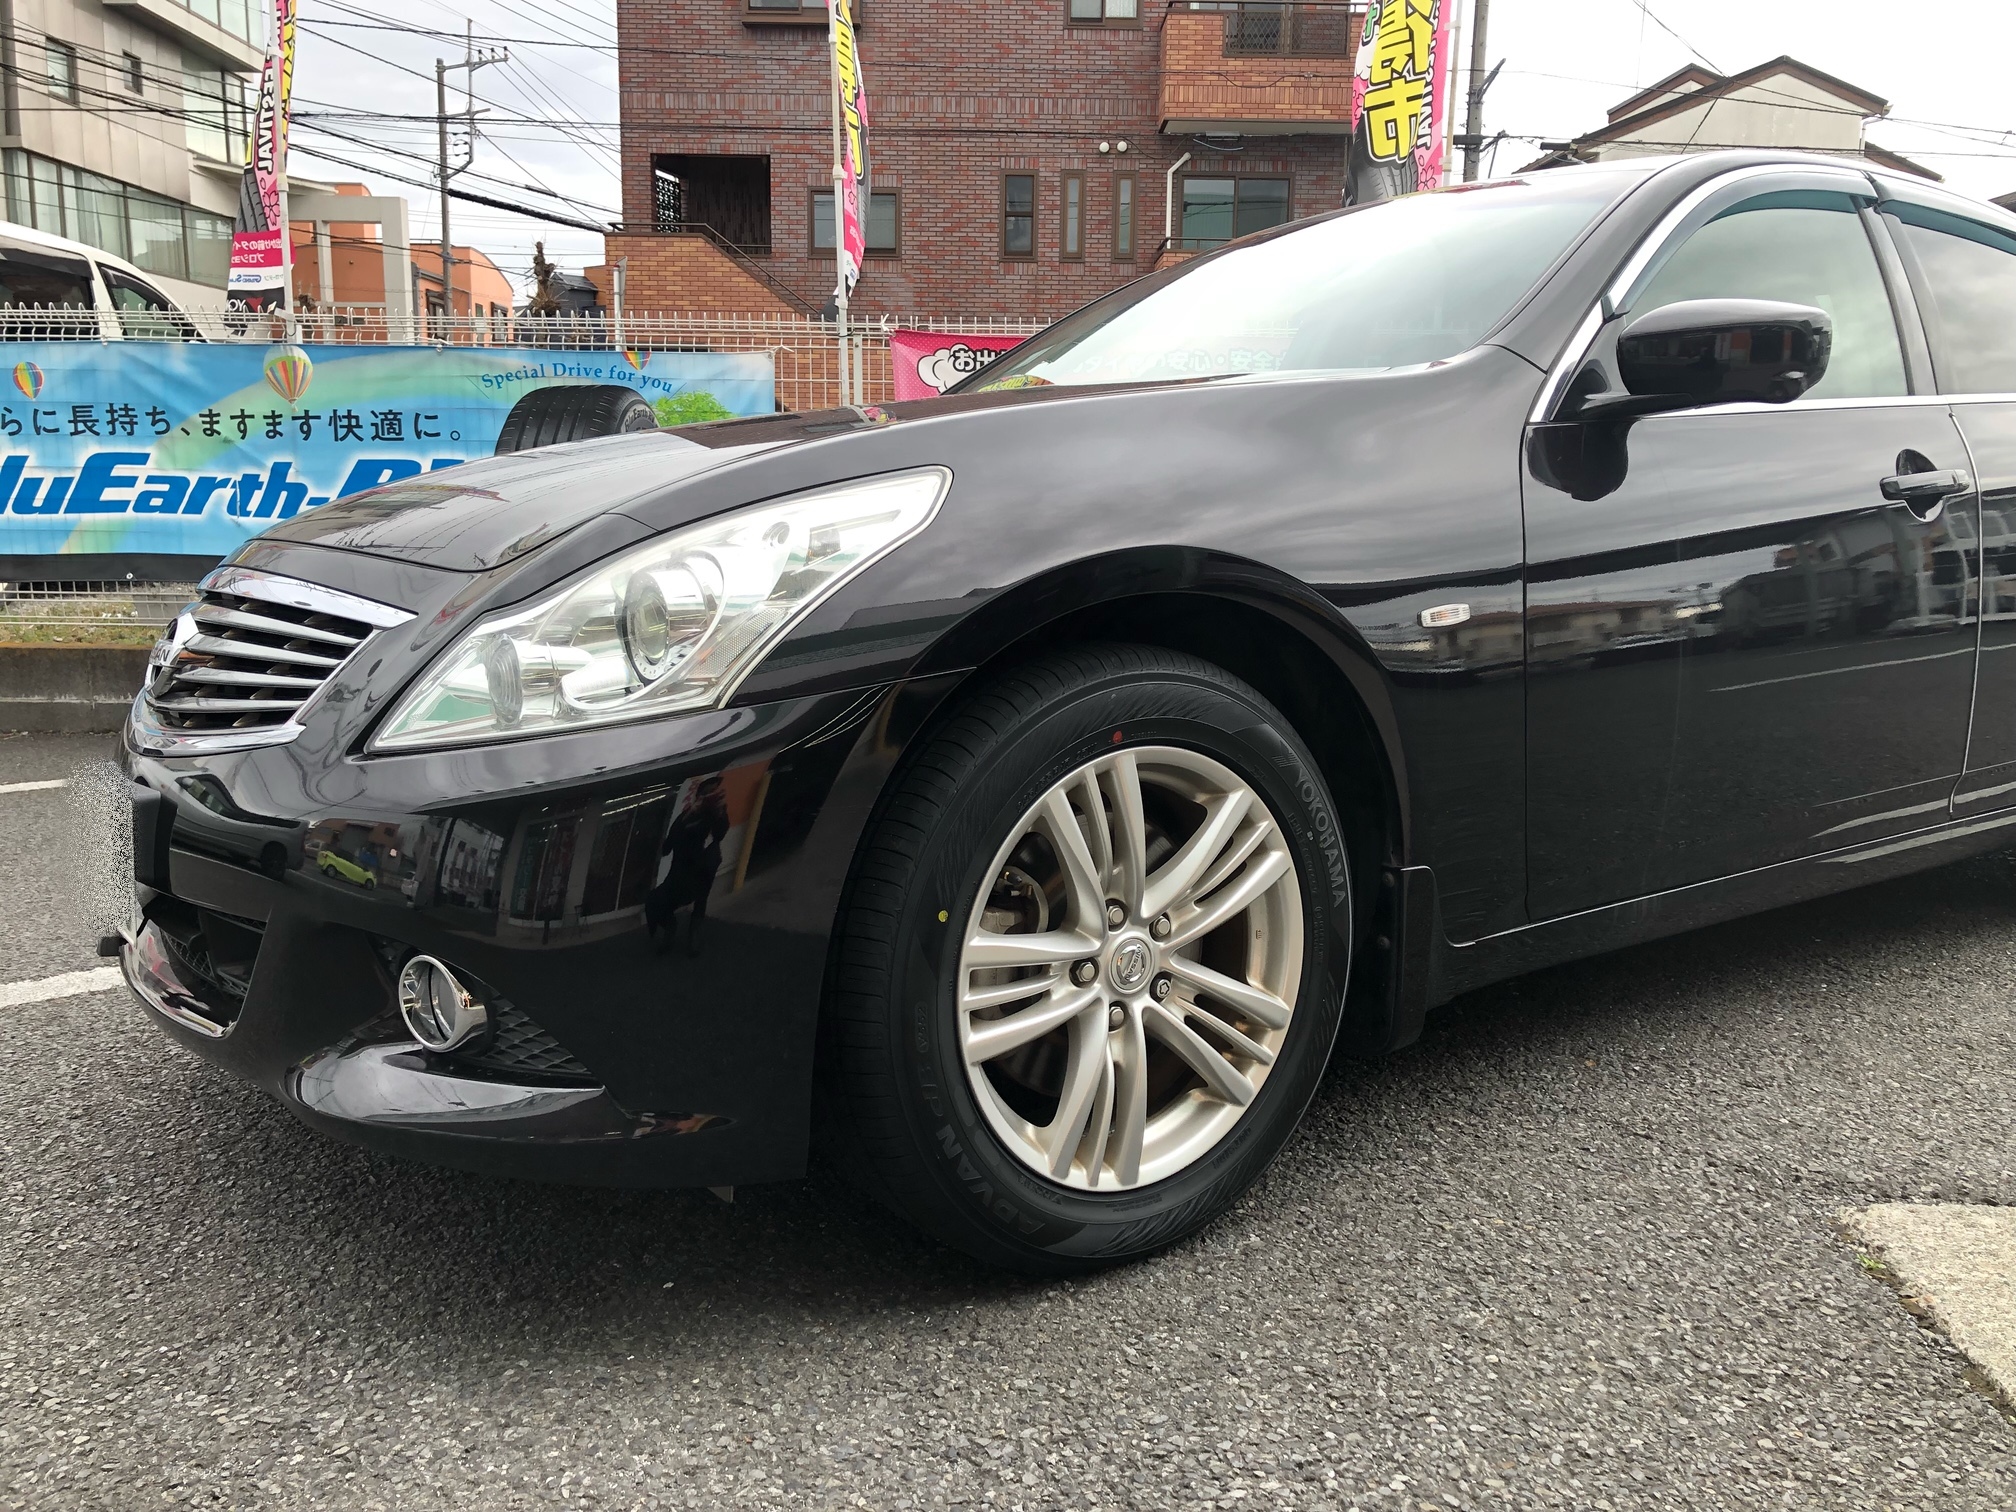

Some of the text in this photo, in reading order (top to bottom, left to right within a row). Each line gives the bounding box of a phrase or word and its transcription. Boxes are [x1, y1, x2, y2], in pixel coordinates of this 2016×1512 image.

[482, 362, 672, 394] Special Drive for you
[954, 349, 1007, 372] お出
[1295, 768, 1346, 908] YOKOHAMA
[936, 1126, 1046, 1236] ADVAN
